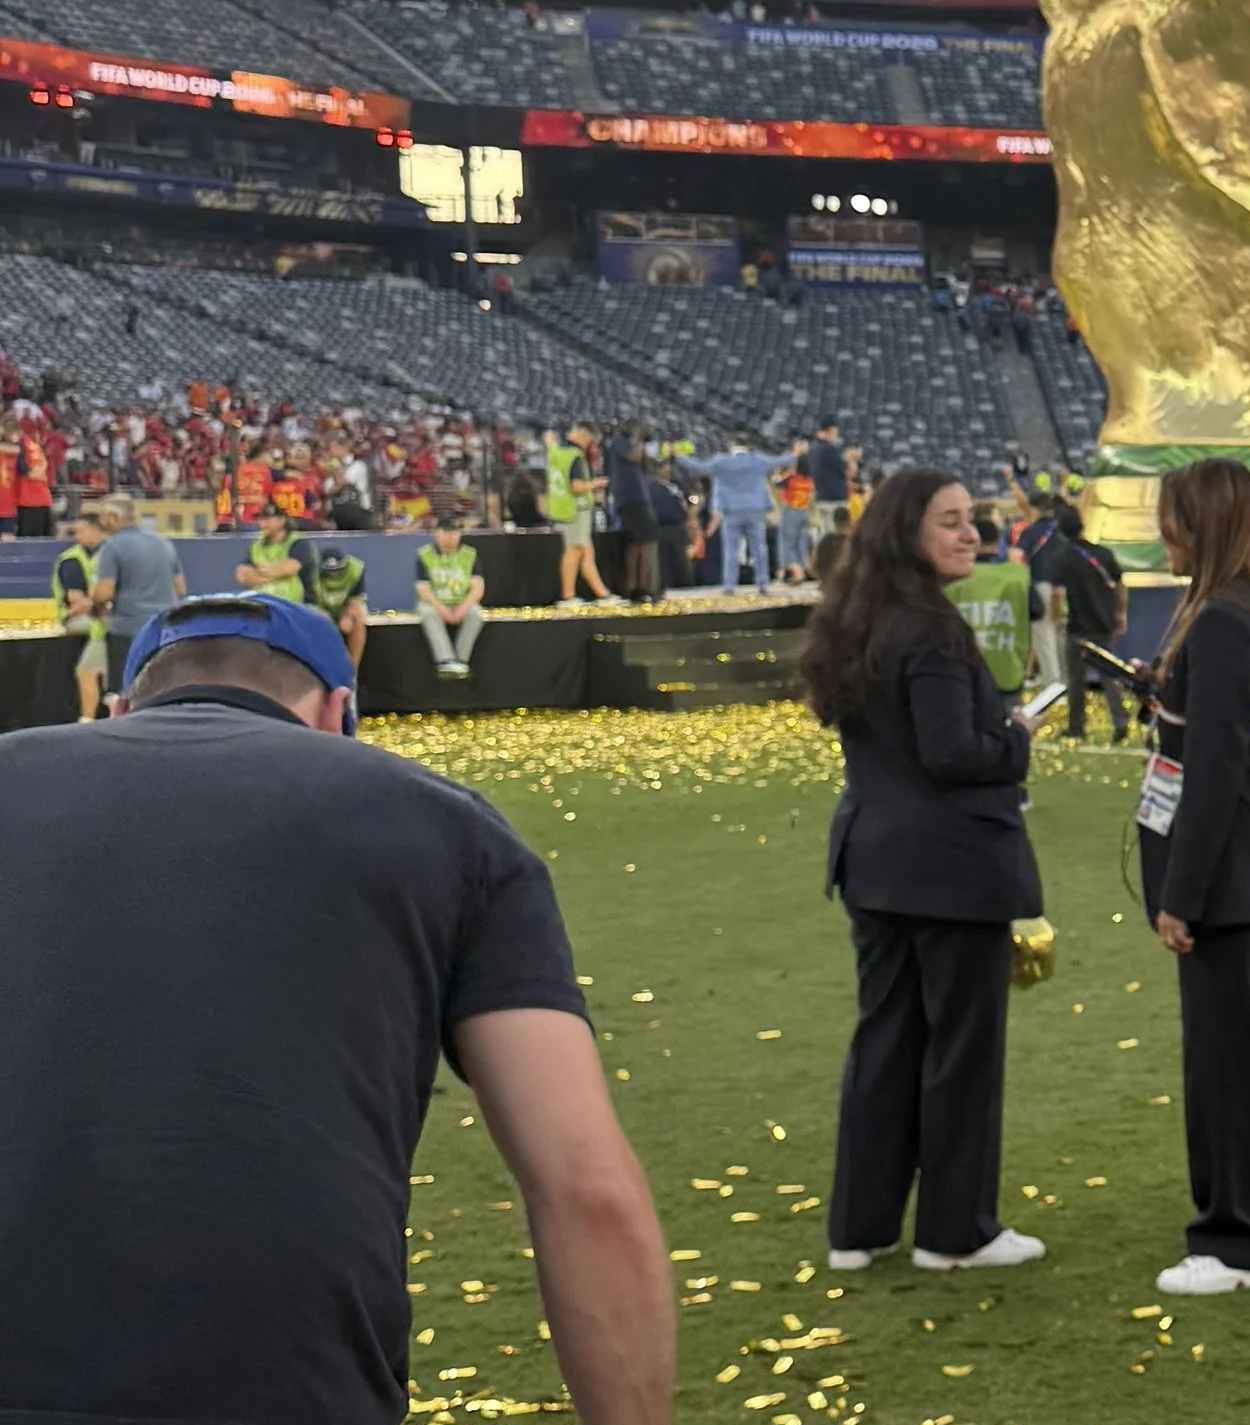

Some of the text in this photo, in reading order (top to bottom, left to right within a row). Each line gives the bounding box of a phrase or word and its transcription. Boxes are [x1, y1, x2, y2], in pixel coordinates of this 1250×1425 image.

[90, 62, 129, 84] FIFA
[129, 67, 188, 93] WORLD
[188, 76, 221, 97] CUP
[587, 118, 768, 149] CHAMPIONS
[996, 136, 1034, 155] FIFA
